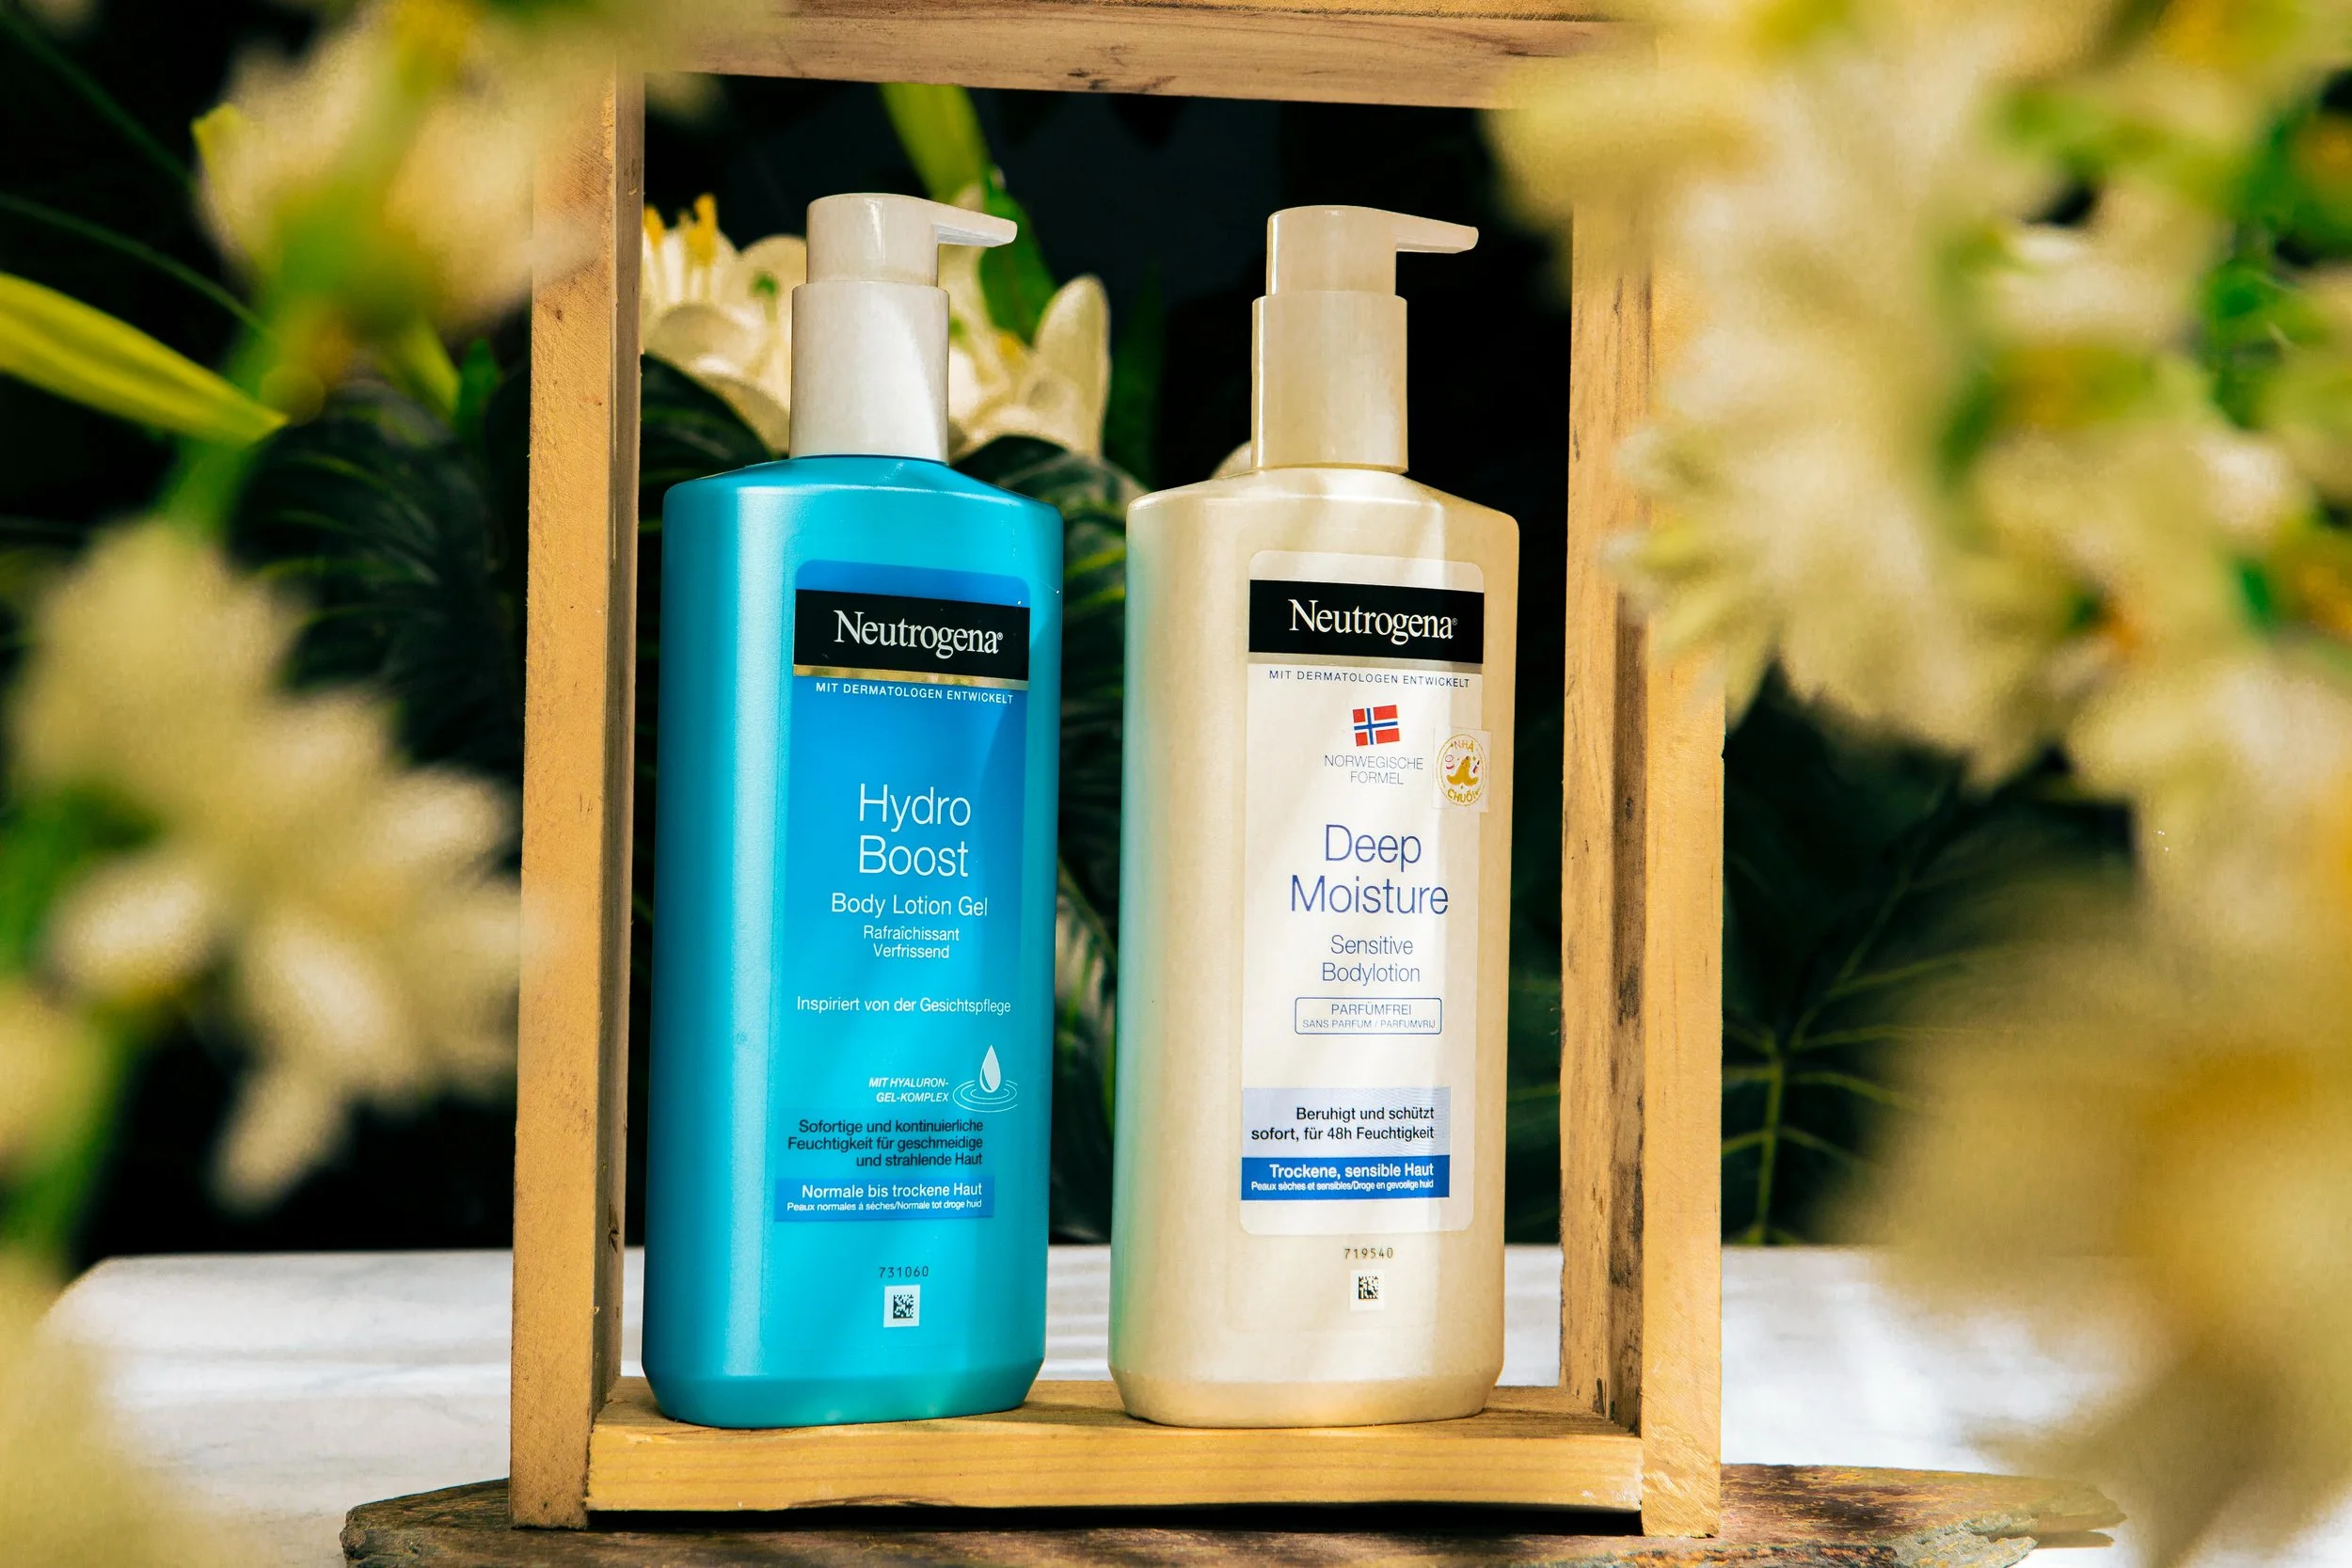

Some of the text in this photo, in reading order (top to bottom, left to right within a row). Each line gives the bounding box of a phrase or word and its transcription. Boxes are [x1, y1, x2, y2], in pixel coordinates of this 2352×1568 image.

[1268, 671, 1470, 689] MIT DERMATOLOGEN ENTWICKELT
[816, 682, 1014, 705] MIT DERMATOLOGEN ENTWICKELT
[1324, 754, 1423, 770] NORWEGISCHE
[1350, 771, 1405, 785] FORMEL
[859, 783, 972, 832] Hydro
[859, 834, 969, 877] Boost
[1325, 824, 1422, 872] Deep
[1291, 874, 1449, 914] Moisture
[831, 893, 988, 918] Body Lotion Gel
[864, 926, 960, 942] Rafraîchissant
[873, 943, 949, 958] Verfrissend
[1330, 934, 1413, 955] Sensitive
[1322, 961, 1420, 986] Bodylotion
[797, 996, 1011, 1016] Inspiriert von der Gesichtspflege
[1331, 1001, 1411, 1015] PARFÜMFREI
[1302, 1020, 1329, 1028] SANS
[1331, 1020, 1372, 1028] PARFUM
[1380, 1020, 1436, 1029] PARFUMVRIJ
[868, 1078, 949, 1088] MIT HYALURON-
[876, 1092, 949, 1102] GEL-KOMPLEX
[1296, 1106, 1435, 1123] Beruhigt und schützt
[799, 1119, 983, 1135] Sofortige und kontinuierliche
[1251, 1126, 1435, 1142] sofort, für 48h Feuchtigkeit
[787, 1136, 983, 1152] Feuchtigkeit für geschmeidige
[856, 1152, 982, 1166] und strahlende Haut
[1269, 1163, 1434, 1180] Trockene, sensible Haut
[802, 1181, 982, 1198] Normale bis trockene Haut
[1251, 1181, 1277, 1191] Peaux
[1278, 1180, 1306, 1191] sèches
[1316, 1180, 1375, 1192] sensibles/Droge
[1386, 1180, 1419, 1191] gevoelige
[1419, 1180, 1434, 1189] huid
[787, 1202, 815, 1212] Peaux
[817, 1202, 856, 1212] normales
[931, 1200, 942, 1210] tot
[943, 1199, 965, 1211] droge
[966, 1199, 982, 1209] huid
[1343, 1246, 1394, 1259] 719540
[879, 1265, 930, 1278] 731060
